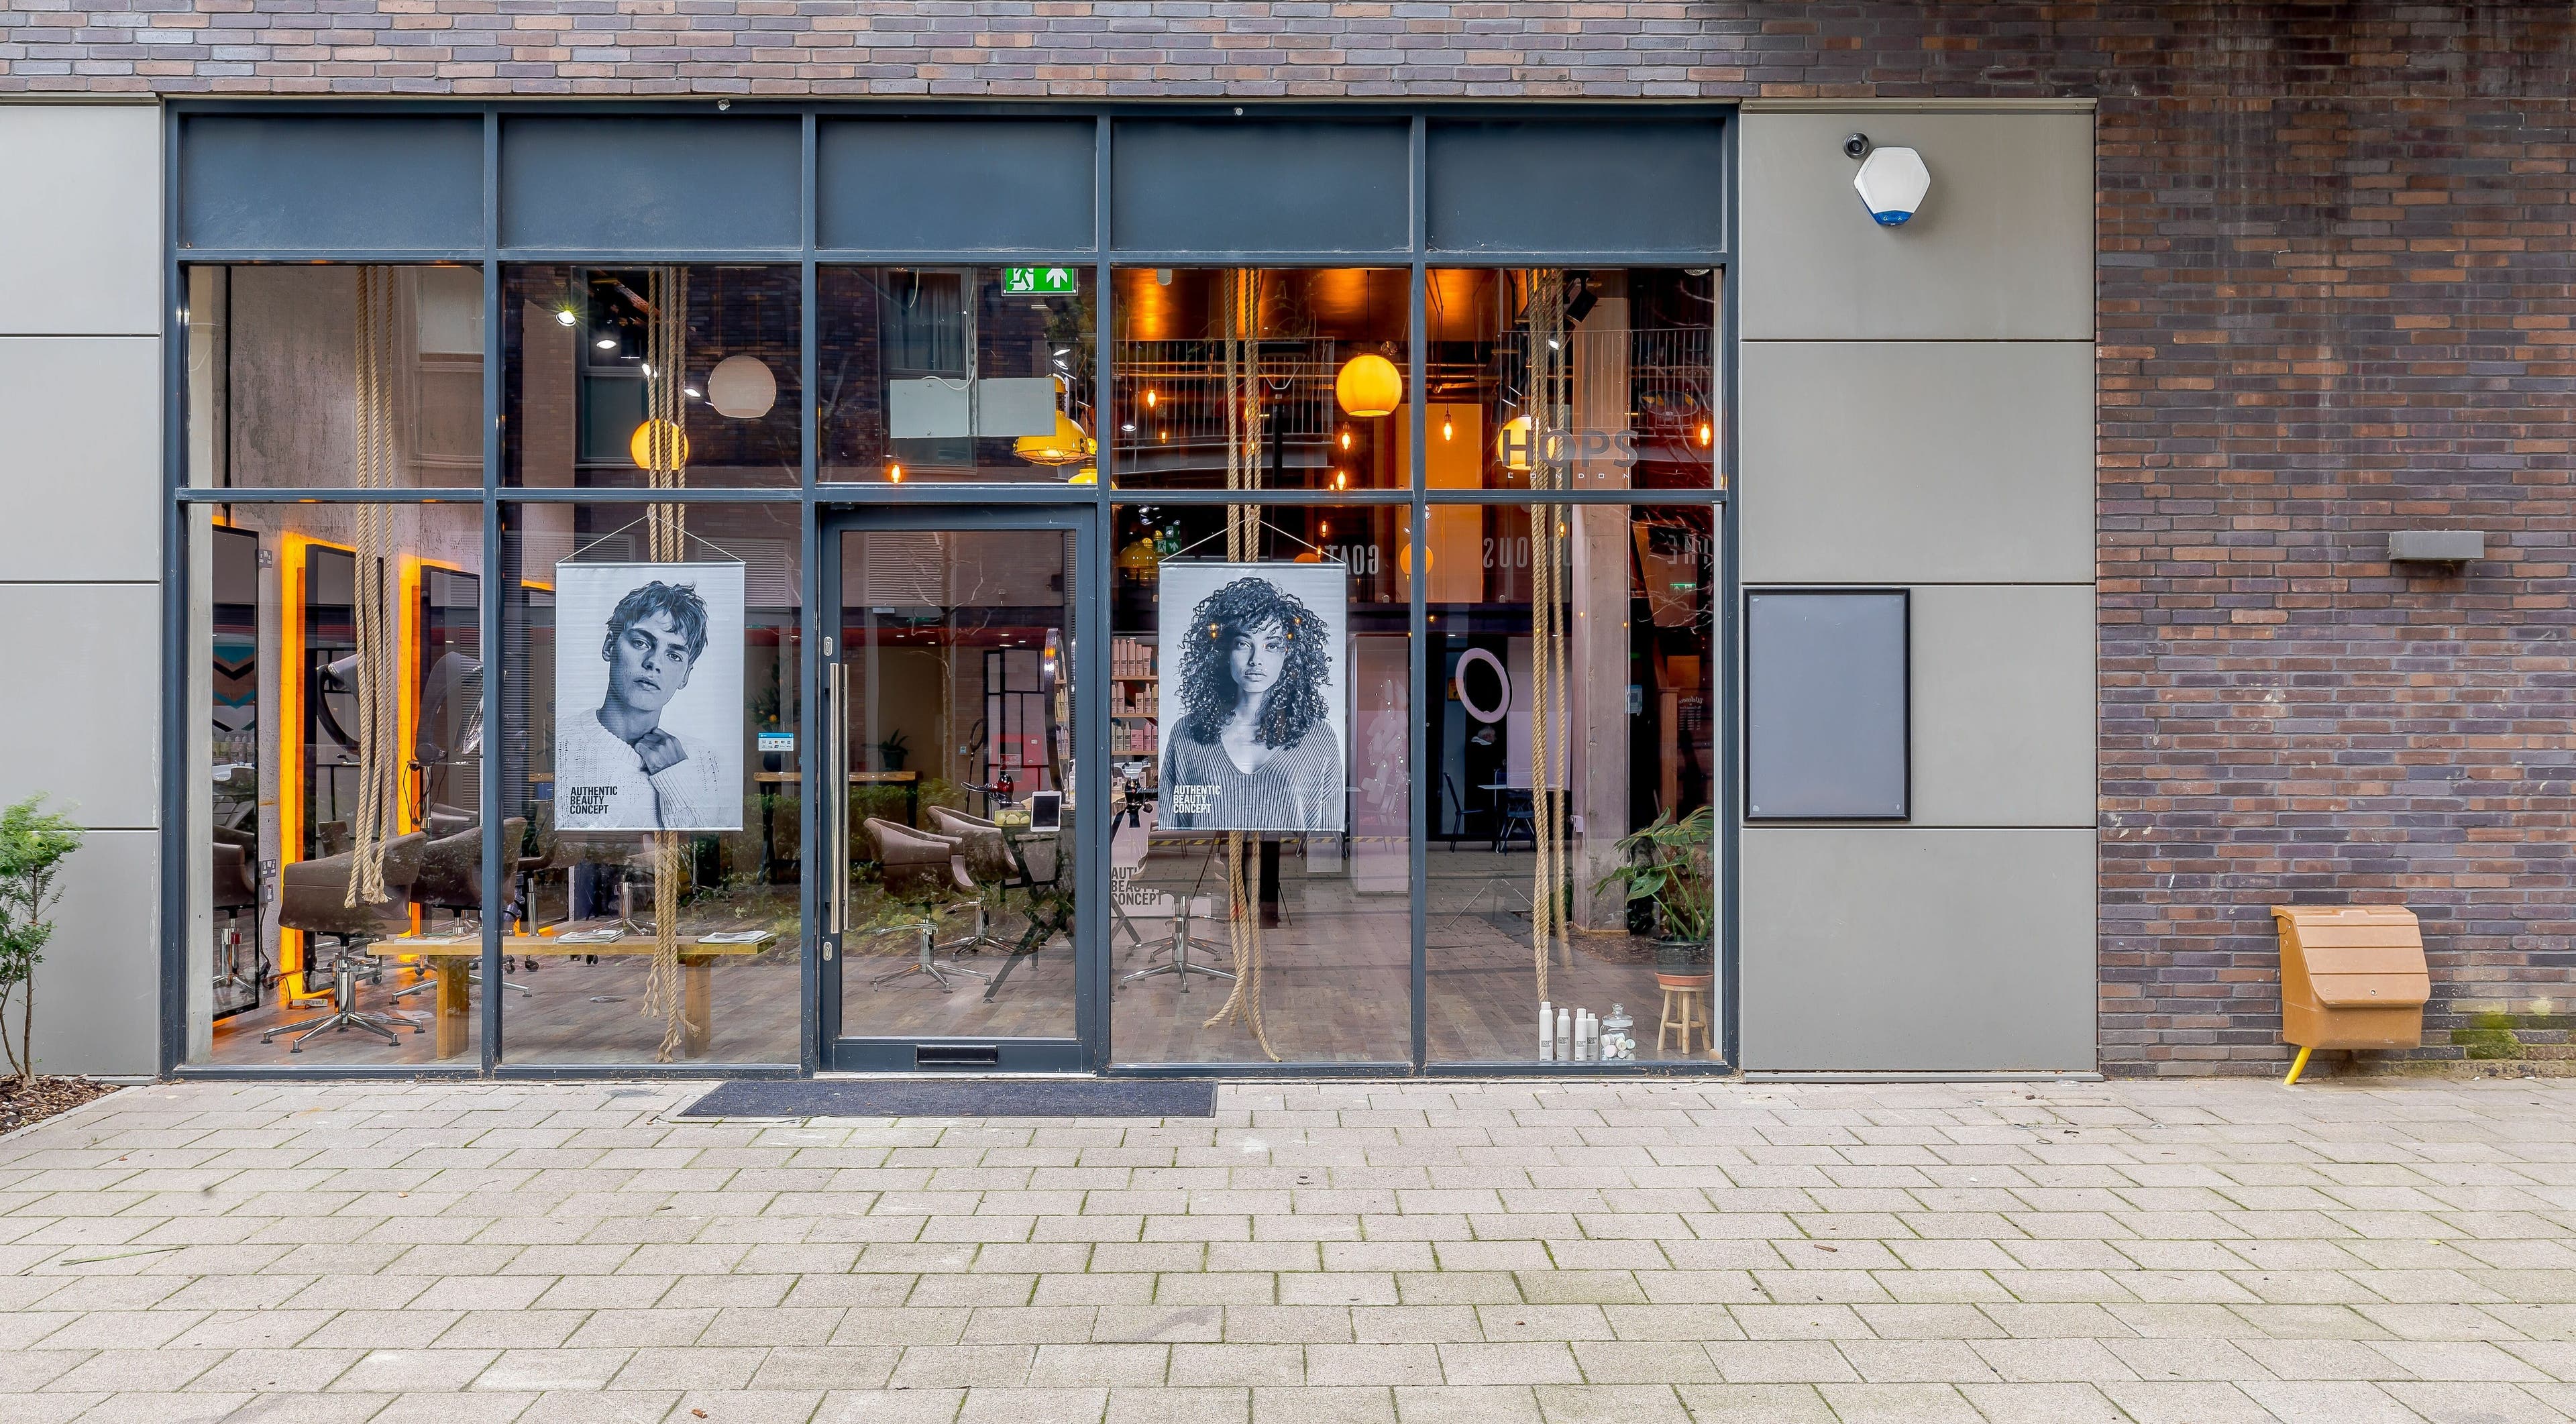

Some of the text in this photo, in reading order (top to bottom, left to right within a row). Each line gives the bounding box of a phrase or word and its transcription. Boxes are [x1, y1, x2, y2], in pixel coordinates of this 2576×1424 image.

[1503, 429, 1638, 468] HOPS
[1507, 472, 1630, 480] LONDON
[571, 786, 618, 796] AUTHENTIC
[1173, 785, 1221, 795] AUTHENTIC
[570, 796, 604, 805] BEAUTY
[1173, 795, 1207, 804] BEAUTY
[570, 805, 609, 814] CONCEPT
[1173, 804, 1212, 814] CONCEPT
